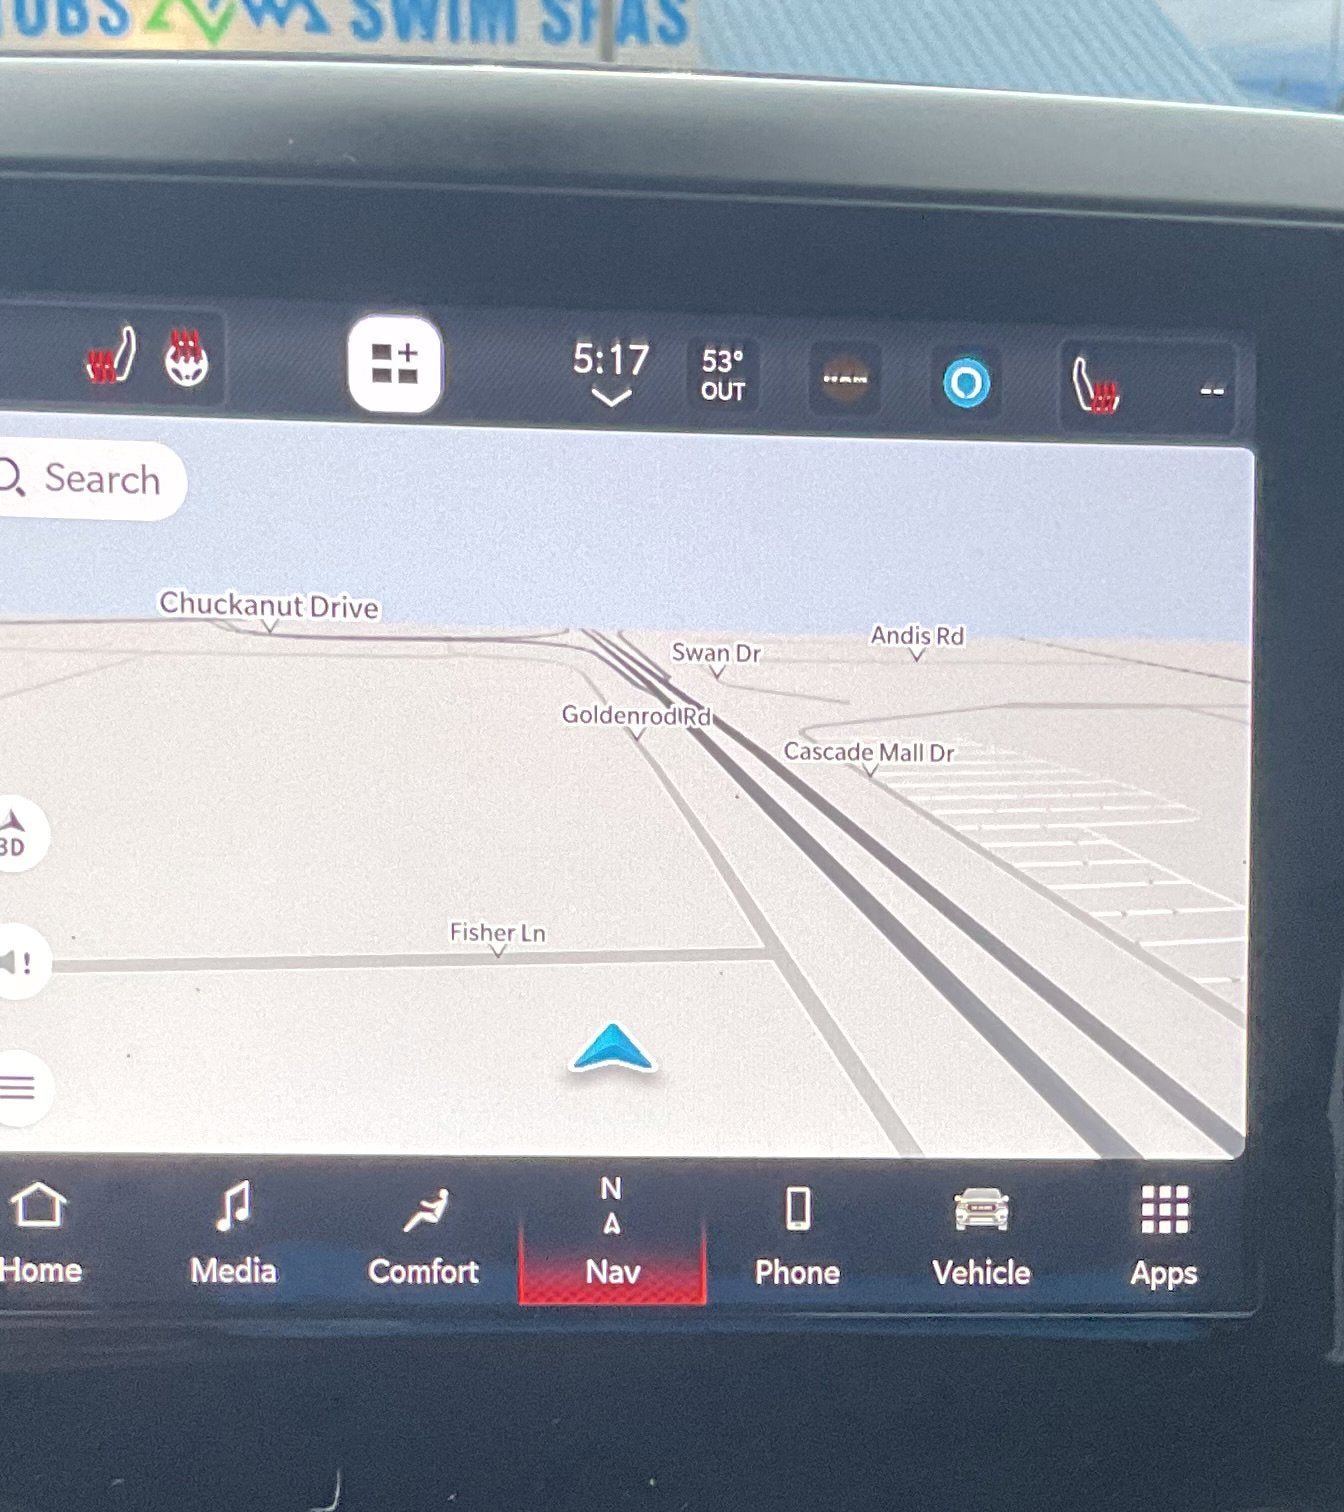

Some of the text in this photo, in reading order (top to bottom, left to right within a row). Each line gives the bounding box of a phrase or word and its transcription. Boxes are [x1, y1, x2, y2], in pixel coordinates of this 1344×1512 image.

[350, 0, 519, 44] SWIM
[572, 342, 650, 377] 5:17
[702, 348, 744, 374] 53°
[701, 381, 746, 402] OUT
[45, 462, 160, 496] Search
[160, 591, 379, 619] Chuckanut Drive
[871, 626, 965, 646] Andis Rd
[672, 643, 762, 663] Swan Dr
[562, 704, 711, 726] Goldenrod Rd
[784, 742, 955, 763] Cascade Mall Dr
[450, 922, 546, 943] Fisher Ln
[601, 1177, 621, 1199] N
[190, 1257, 278, 1284] Media
[368, 1257, 480, 1285] Comfort
[585, 1259, 641, 1285] Nav
[755, 1259, 841, 1285] Phone
[931, 1259, 1031, 1286] Vehicle
[1130, 1260, 1198, 1292] Apps
